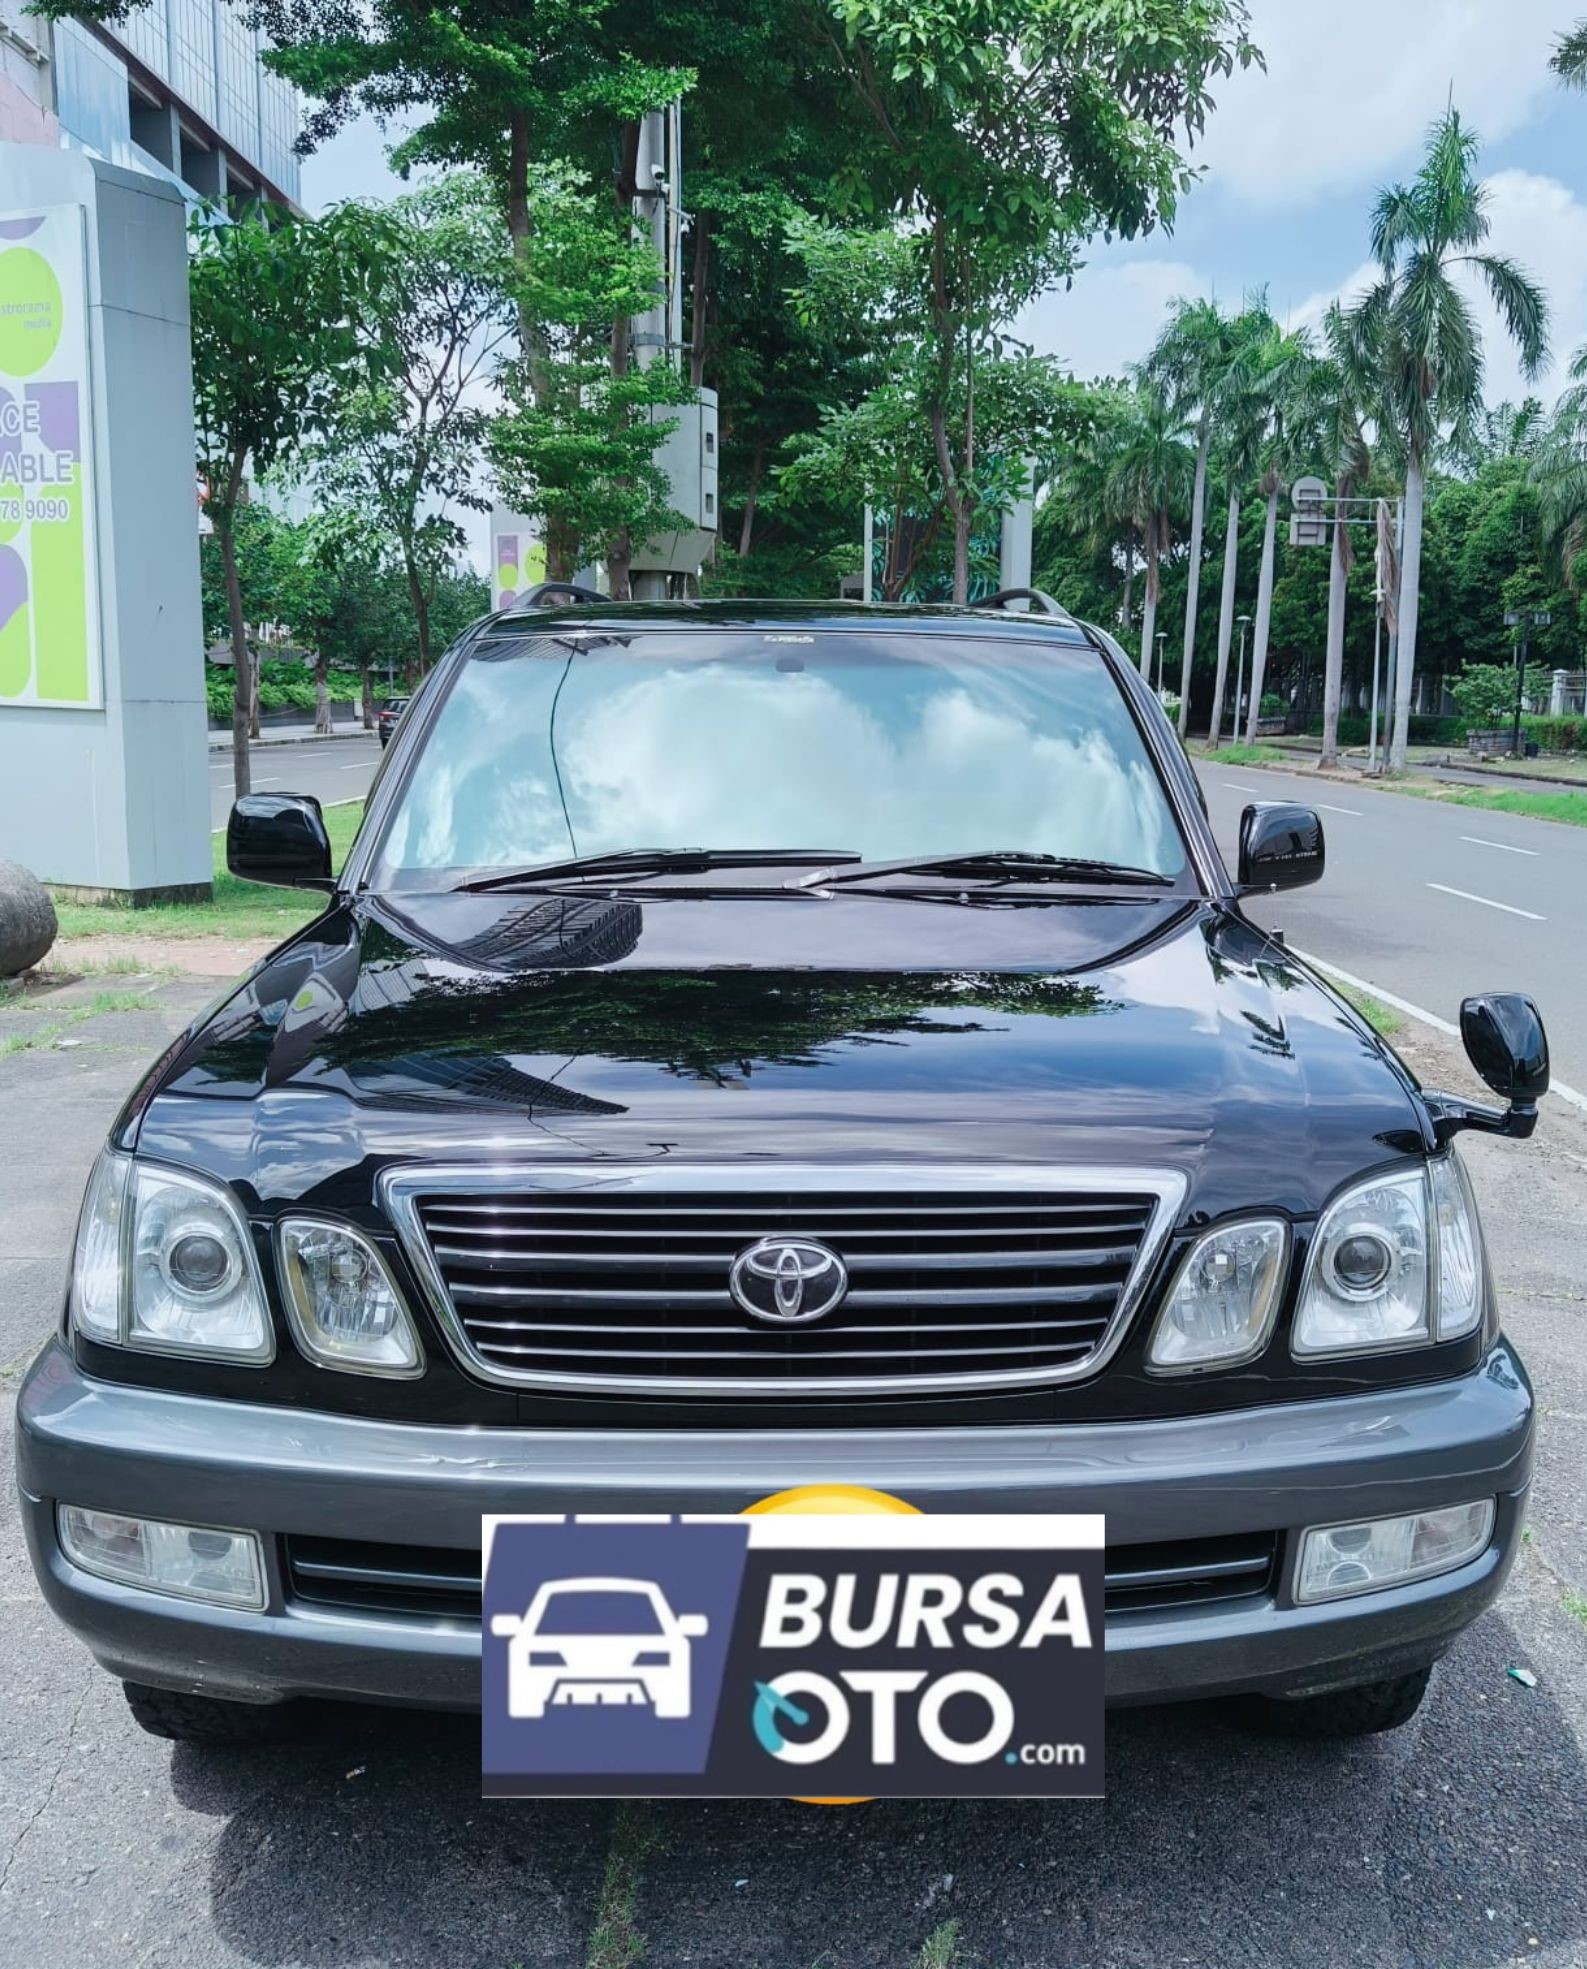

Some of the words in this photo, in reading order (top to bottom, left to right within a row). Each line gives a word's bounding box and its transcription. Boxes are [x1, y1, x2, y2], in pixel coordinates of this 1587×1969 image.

[0, 402, 40, 434] CE
[1, 453, 73, 484] ABLE
[25, 500, 68, 519] 9090
